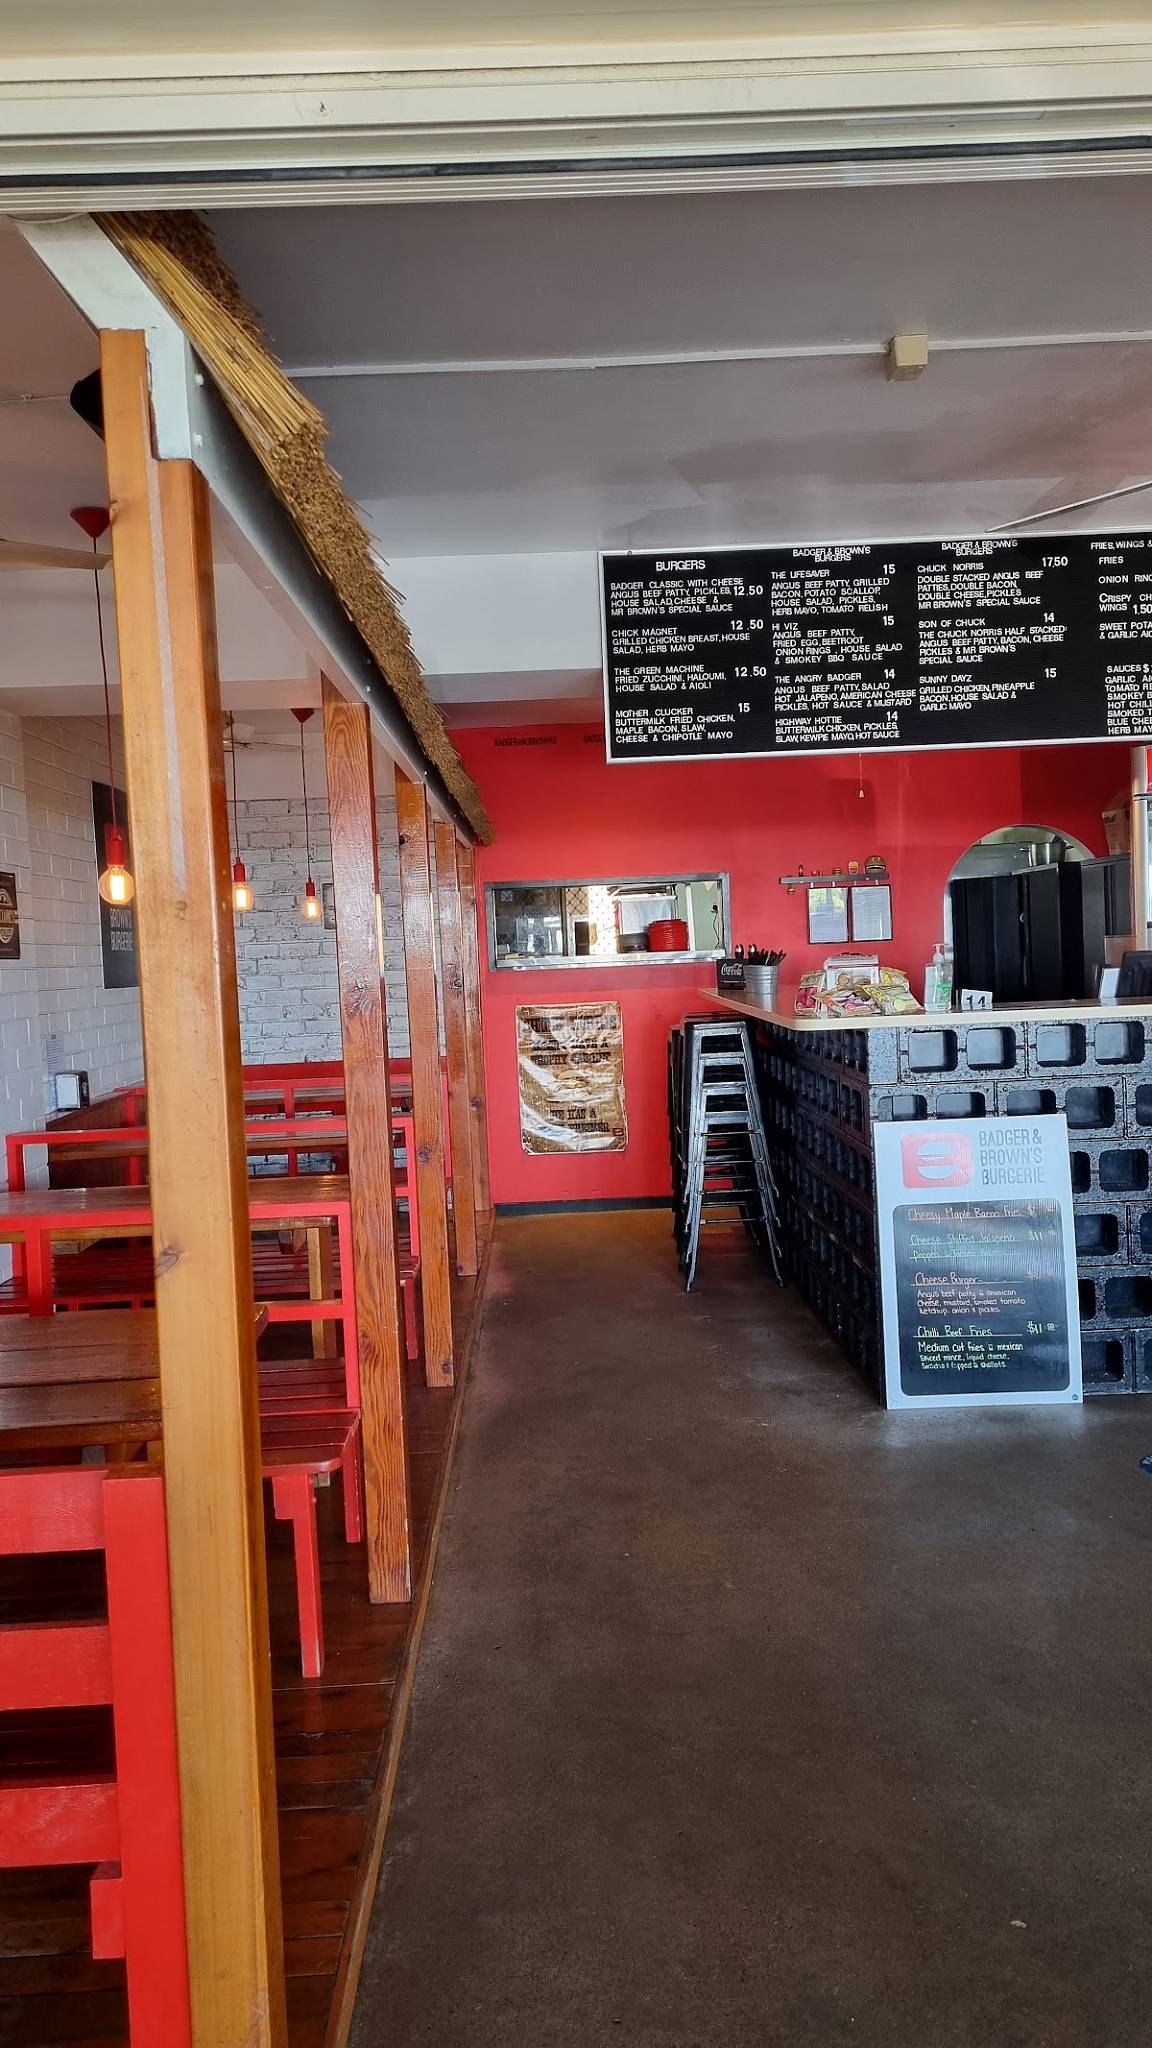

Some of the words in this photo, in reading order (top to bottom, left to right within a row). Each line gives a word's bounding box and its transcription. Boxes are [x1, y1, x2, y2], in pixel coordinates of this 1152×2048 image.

[793, 548, 825, 557] BADGER
[835, 546, 871, 555] BROWN'S
[656, 560, 706, 571] BURGERS
[1099, 556, 1123, 565] FRIES
[883, 564, 895, 575] 15
[918, 564, 946, 573] CHUCK
[953, 563, 984, 572] NORRIS
[790, 570, 830, 578] LIFESAVER
[918, 575, 949, 584] DOUBLE
[952, 573, 990, 582] STACKED
[993, 572, 1020, 581] ANGUS
[610, 582, 643, 590] BADGER
[711, 578, 743, 586] CHEESE
[772, 582, 801, 590] ANGUS
[805, 581, 823, 589] BEEF
[853, 578, 890, 586] GRILLED
[1099, 575, 1128, 584] ONION
[610, 591, 639, 599] ANGUS
[734, 586, 763, 596] 12.50
[918, 602, 931, 610] MR
[934, 599, 971, 608] BROWN'S
[976, 598, 1010, 607] SPECIAL
[1013, 597, 1041, 605] SAUCE
[1099, 603, 1127, 612] WINGS
[611, 608, 623, 616] MR
[628, 606, 665, 616] BROWN'S
[669, 605, 702, 613] SPECIAL
[705, 604, 733, 612] SAUCE
[772, 608, 792, 616] HERB
[821, 605, 854, 614] TOMATO
[859, 604, 888, 612] RELISH
[883, 616, 894, 626] 15
[1044, 612, 1054, 623] 14
[918, 620, 937, 628] SON
[941, 620, 952, 628] OF
[955, 618, 986, 627] CHUCK
[1100, 622, 1127, 631] SWEET
[612, 629, 638, 637] CHICK
[642, 628, 678, 636] MAGNET
[646, 645, 667, 653] HERB
[670, 644, 694, 652] MAYO
[920, 648, 952, 656] PICKLES
[955, 647, 961, 655] &
[963, 646, 976, 654] MR
[979, 644, 1016, 653] BROWN'S
[785, 655, 822, 664] SMOKEY
[852, 653, 883, 661] SAUCE
[919, 656, 953, 664] SPECIAL
[956, 655, 983, 663] SAUCE
[666, 665, 704, 673] MACHINE
[735, 666, 766, 677] 12.50
[884, 669, 895, 679] 14
[1044, 668, 1057, 678] 15
[1107, 665, 1142, 673] SAUCES
[615, 676, 639, 684] FRIED
[774, 676, 790, 684] THE
[795, 674, 822, 682] ANGRY
[827, 673, 861, 681] BADGER
[919, 675, 948, 684] SUNNY
[951, 674, 972, 682] DAYZ
[1105, 675, 1136, 684] GARLIC
[616, 684, 644, 692] HOUSE
[650, 683, 677, 691] SALAD
[1105, 684, 1140, 692] TOMATO
[775, 695, 792, 703] HOT
[840, 691, 882, 700] AMERICAN
[885, 690, 916, 698] CHEESE
[1107, 692, 1144, 700] SMOKEY
[738, 703, 750, 713] 15
[834, 700, 862, 709] SAUCE
[867, 700, 872, 708] &
[874, 698, 912, 707] MUSTARD
[920, 703, 948, 711] GARLIC
[949, 702, 972, 710] MAYO
[1108, 701, 1125, 709] HOT
[616, 709, 648, 718] MOTHER
[655, 708, 693, 716] CLUCKER
[886, 711, 898, 721] 14
[1108, 709, 1144, 717] SMOKED
[616, 717, 666, 726] BUTTERMILK
[670, 716, 693, 724] FRIED
[775, 718, 812, 726] HIGHWAY
[815, 716, 842, 724] HOTTIE
[1107, 718, 1128, 726] BLUE
[616, 727, 643, 735] MAPLE
[1108, 726, 1131, 734] HERB
[616, 735, 648, 743] CHEESE
[662, 733, 702, 741] CHIPOTLE
[708, 731, 733, 739] MAYO
[980, 1129, 1029, 1146] BADGER
[1033, 1128, 1043, 1144] &
[981, 1148, 1042, 1166] BROWN'S
[982, 1167, 1044, 1185] BURGERIE
[908, 1209, 940, 1224] Cheesy
[945, 1206, 970, 1223] Maple
[915, 1272, 947, 1285] Cheese
[950, 1271, 978, 1289] Burger
[918, 1326, 939, 1336] Chilli
[945, 1325, 962, 1336] Beef
[970, 1325, 992, 1336] Fries
[918, 1342, 949, 1352] Medium
[952, 1342, 964, 1351] cut
